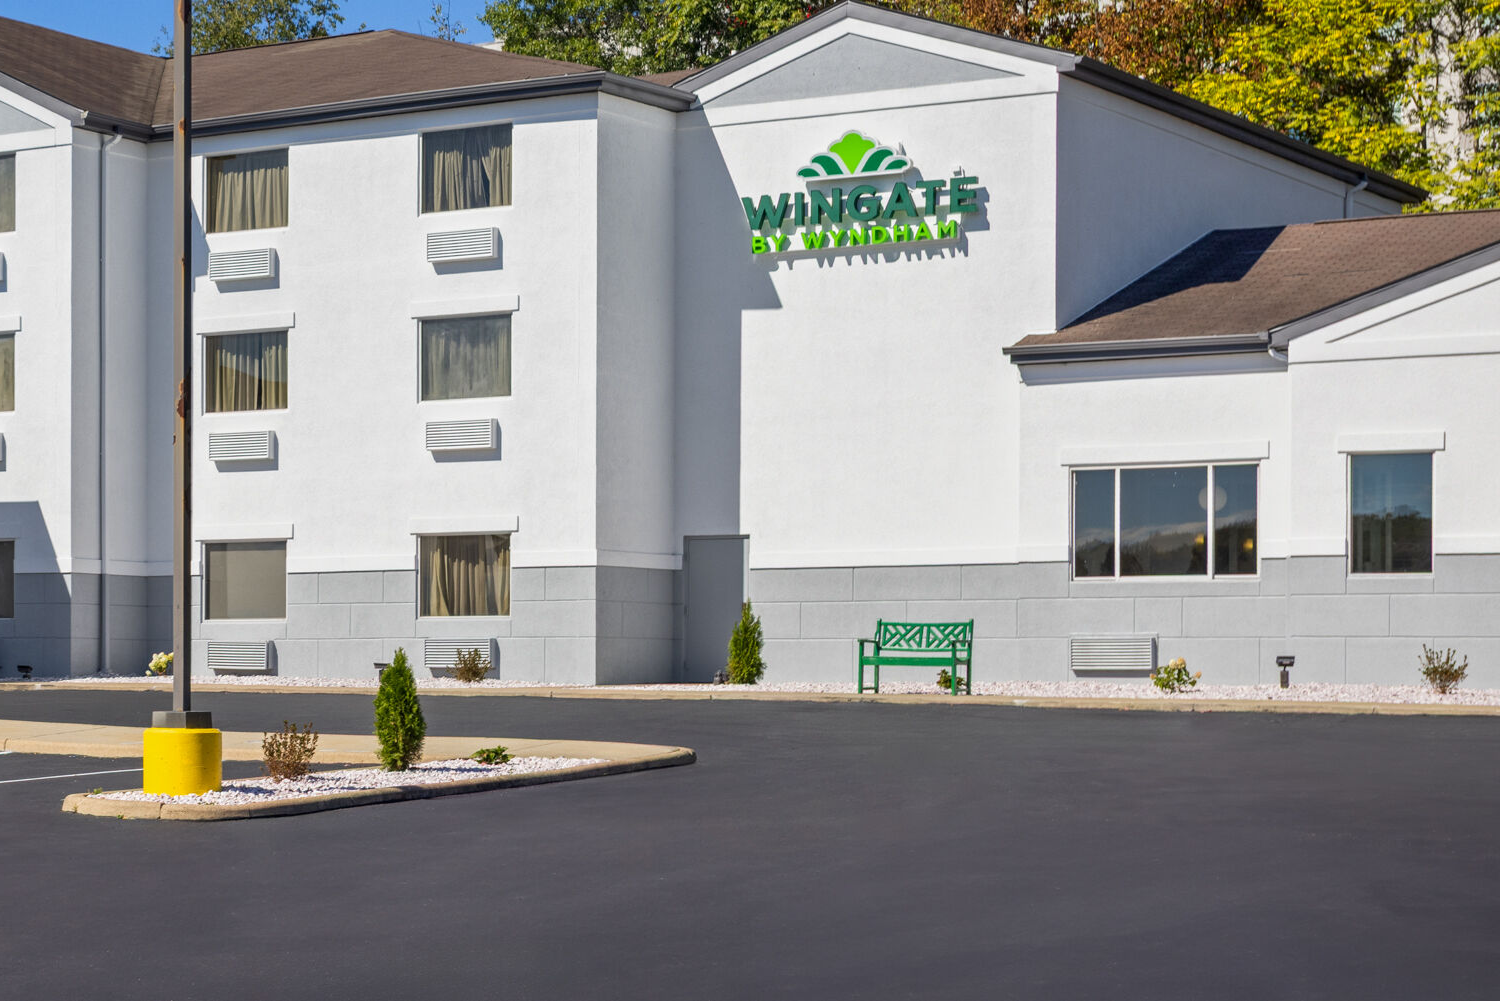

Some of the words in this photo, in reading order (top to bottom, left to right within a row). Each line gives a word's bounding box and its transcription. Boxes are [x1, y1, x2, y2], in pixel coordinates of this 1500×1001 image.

[741, 176, 979, 230] WINGATE
[751, 234, 788, 254] BY
[801, 220, 957, 250] WYNDHAM
